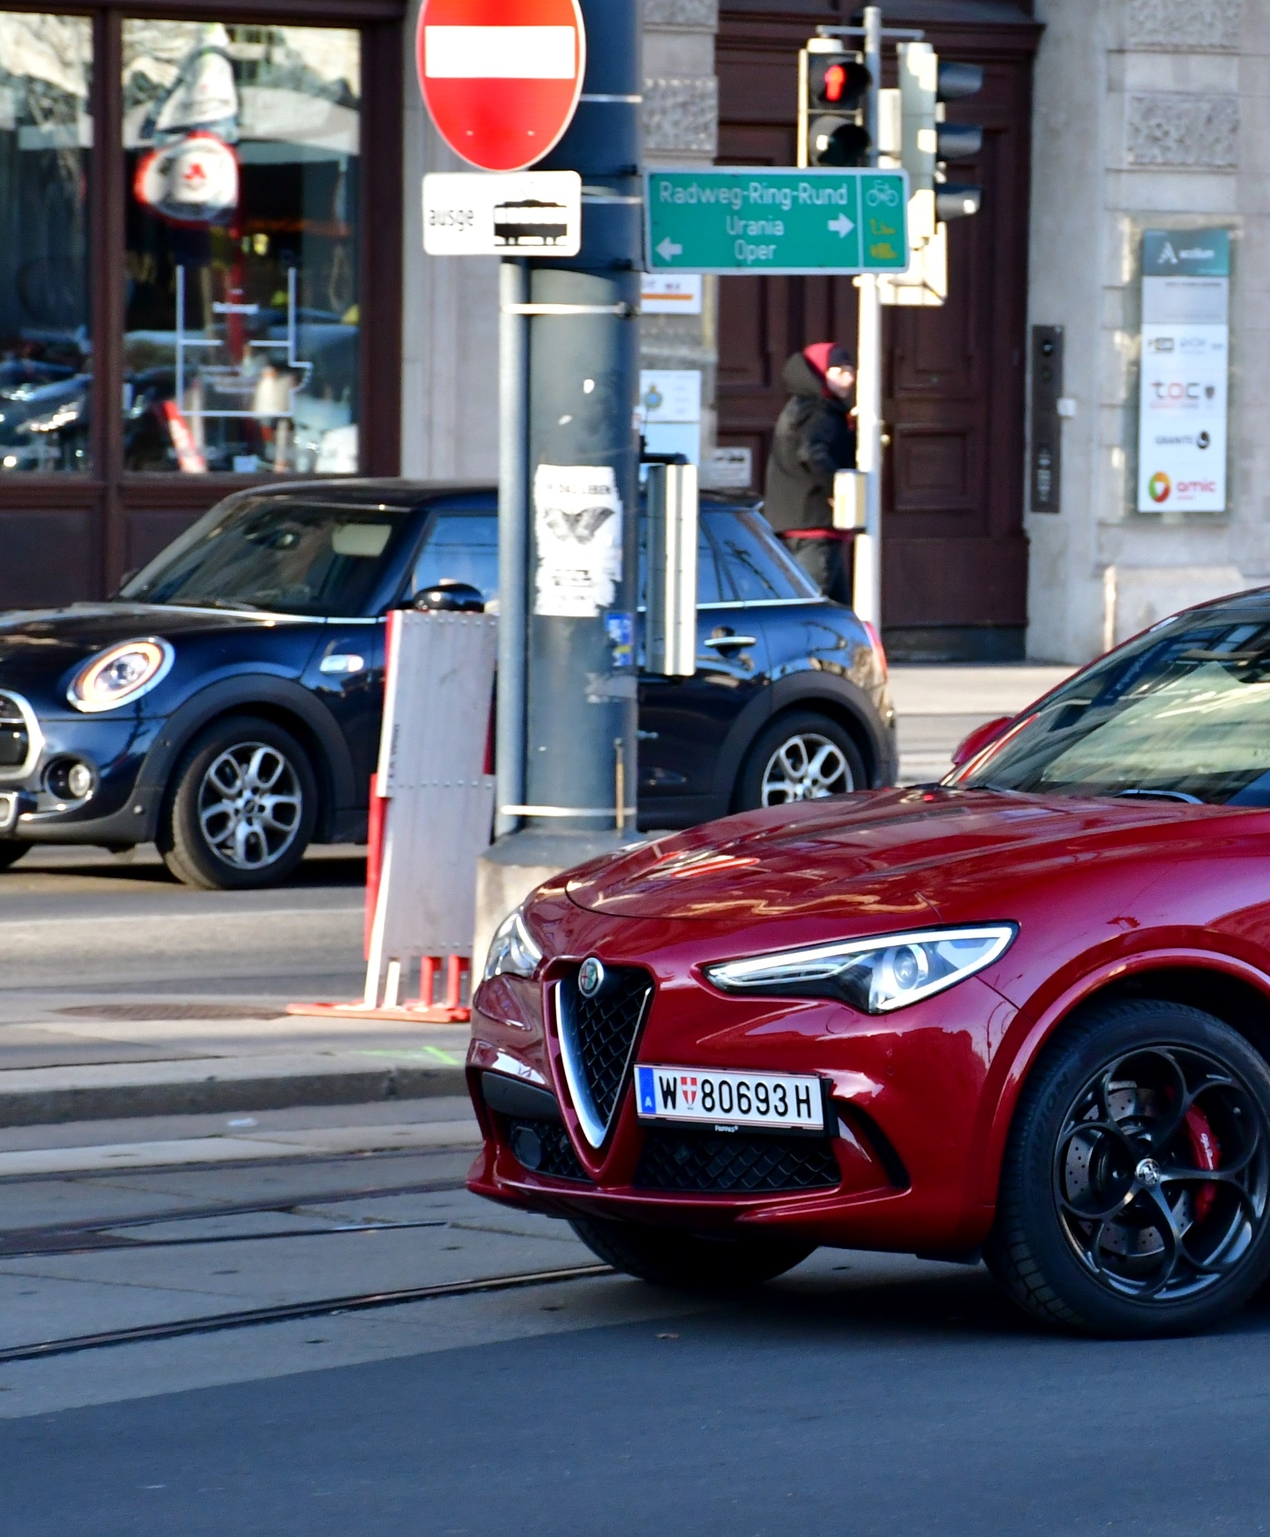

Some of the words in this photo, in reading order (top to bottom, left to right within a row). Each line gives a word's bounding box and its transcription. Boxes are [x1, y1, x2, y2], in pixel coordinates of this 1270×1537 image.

[659, 181, 848, 210] Radweg-Ring-Rund
[429, 209, 474, 232] ausge
[726, 215, 785, 236] Urania
[734, 239, 776, 263] Oper
[659, 1076, 677, 1110] W
